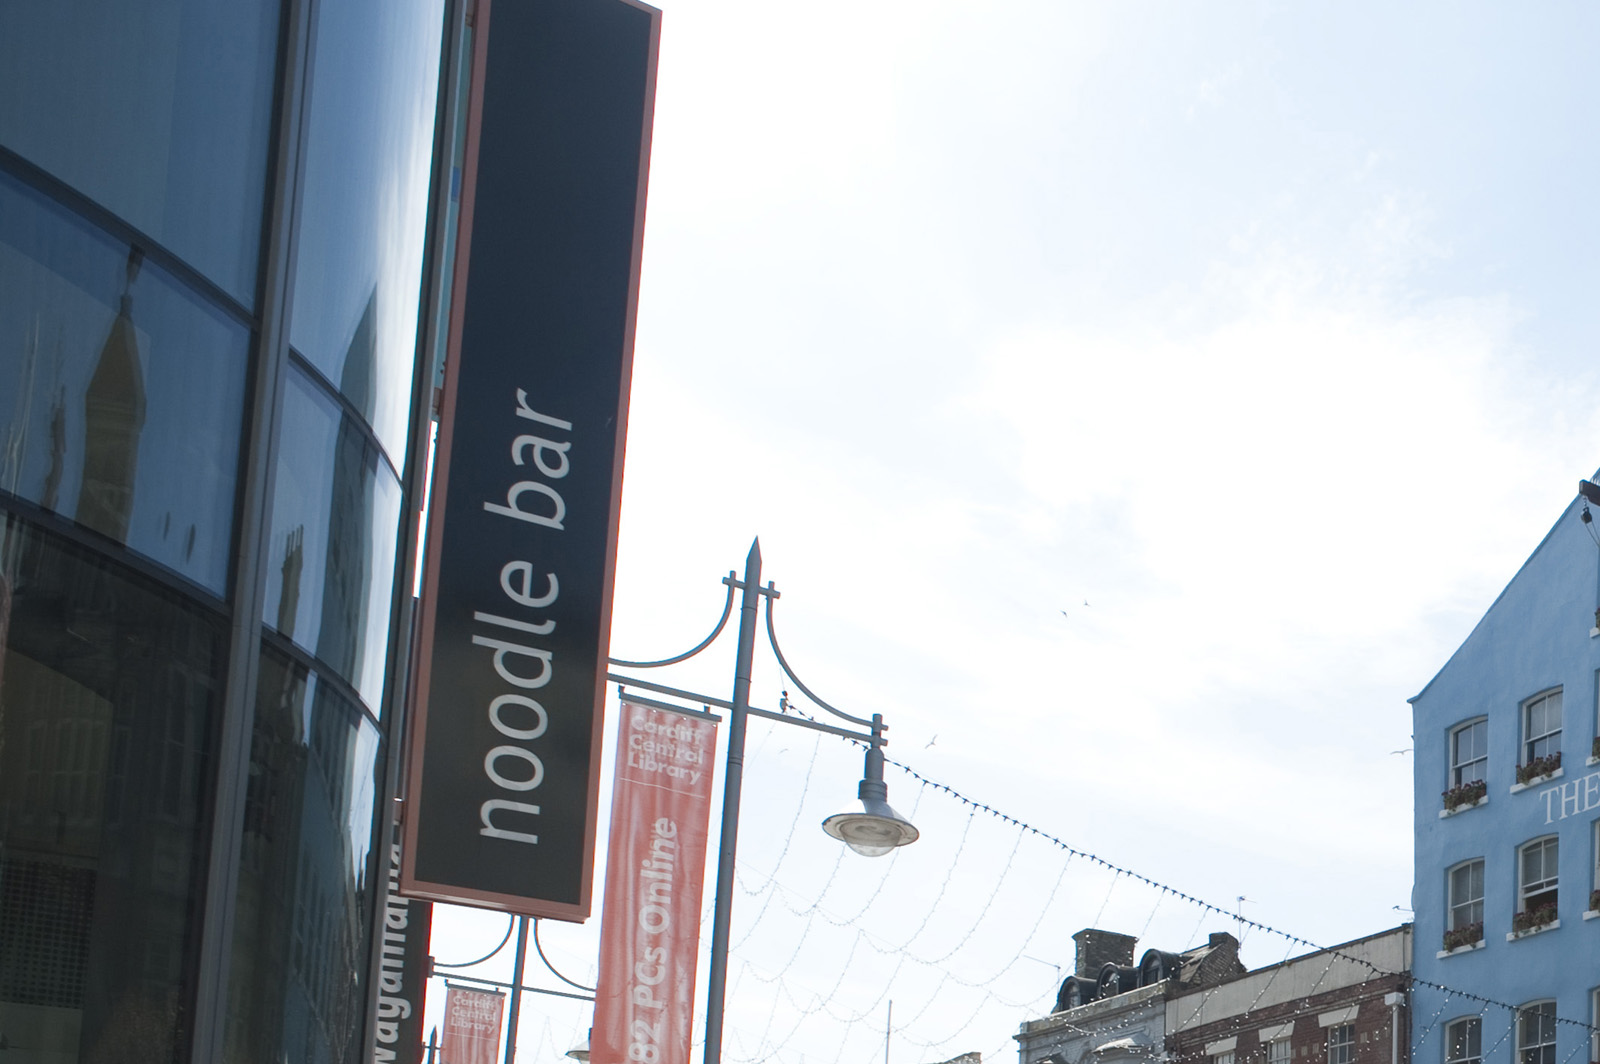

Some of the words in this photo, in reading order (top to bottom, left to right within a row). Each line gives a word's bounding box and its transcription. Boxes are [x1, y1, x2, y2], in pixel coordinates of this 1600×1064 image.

[484, 388, 574, 531] bar
[472, 560, 561, 845] noodle
[630, 715, 704, 745] Cardiff
[629, 734, 705, 765] Central
[627, 752, 702, 786] Library
[637, 816, 678, 934] Online
[631, 946, 668, 1011] PCs
[450, 1016, 495, 1034] Library
[451, 1006, 497, 1022] Central
